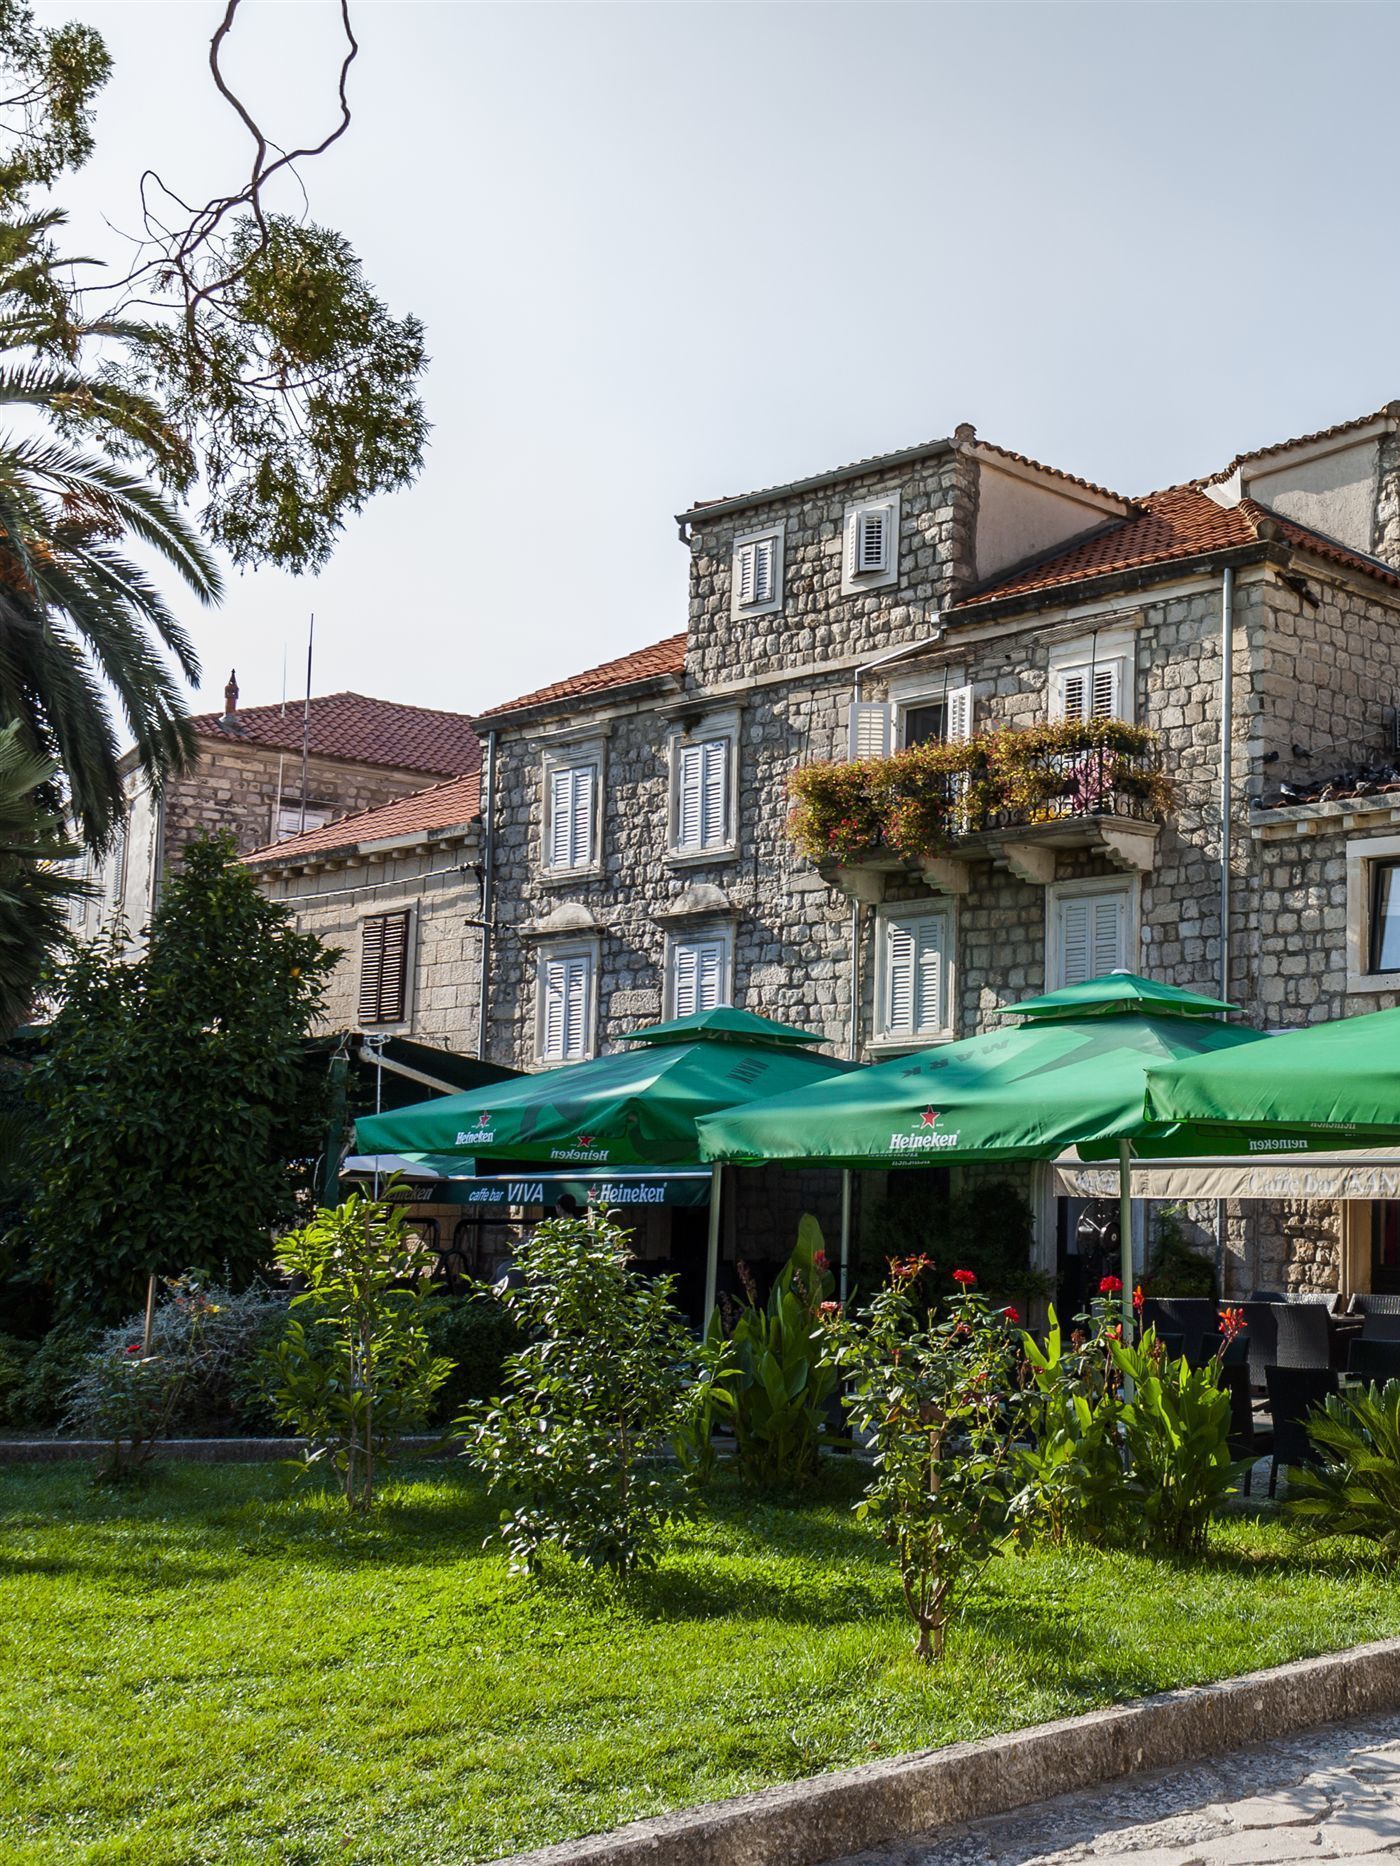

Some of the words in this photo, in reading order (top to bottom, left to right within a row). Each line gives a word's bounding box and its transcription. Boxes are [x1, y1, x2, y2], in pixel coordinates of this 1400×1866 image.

[455, 1130, 495, 1145] Heineken
[889, 1132, 958, 1149] Heineken
[468, 1187, 490, 1202] caffe
[489, 1187, 505, 1201] bar
[507, 1183, 544, 1202] VIVA
[600, 1182, 665, 1203] Heineken
[1303, 1173, 1336, 1193] bar
